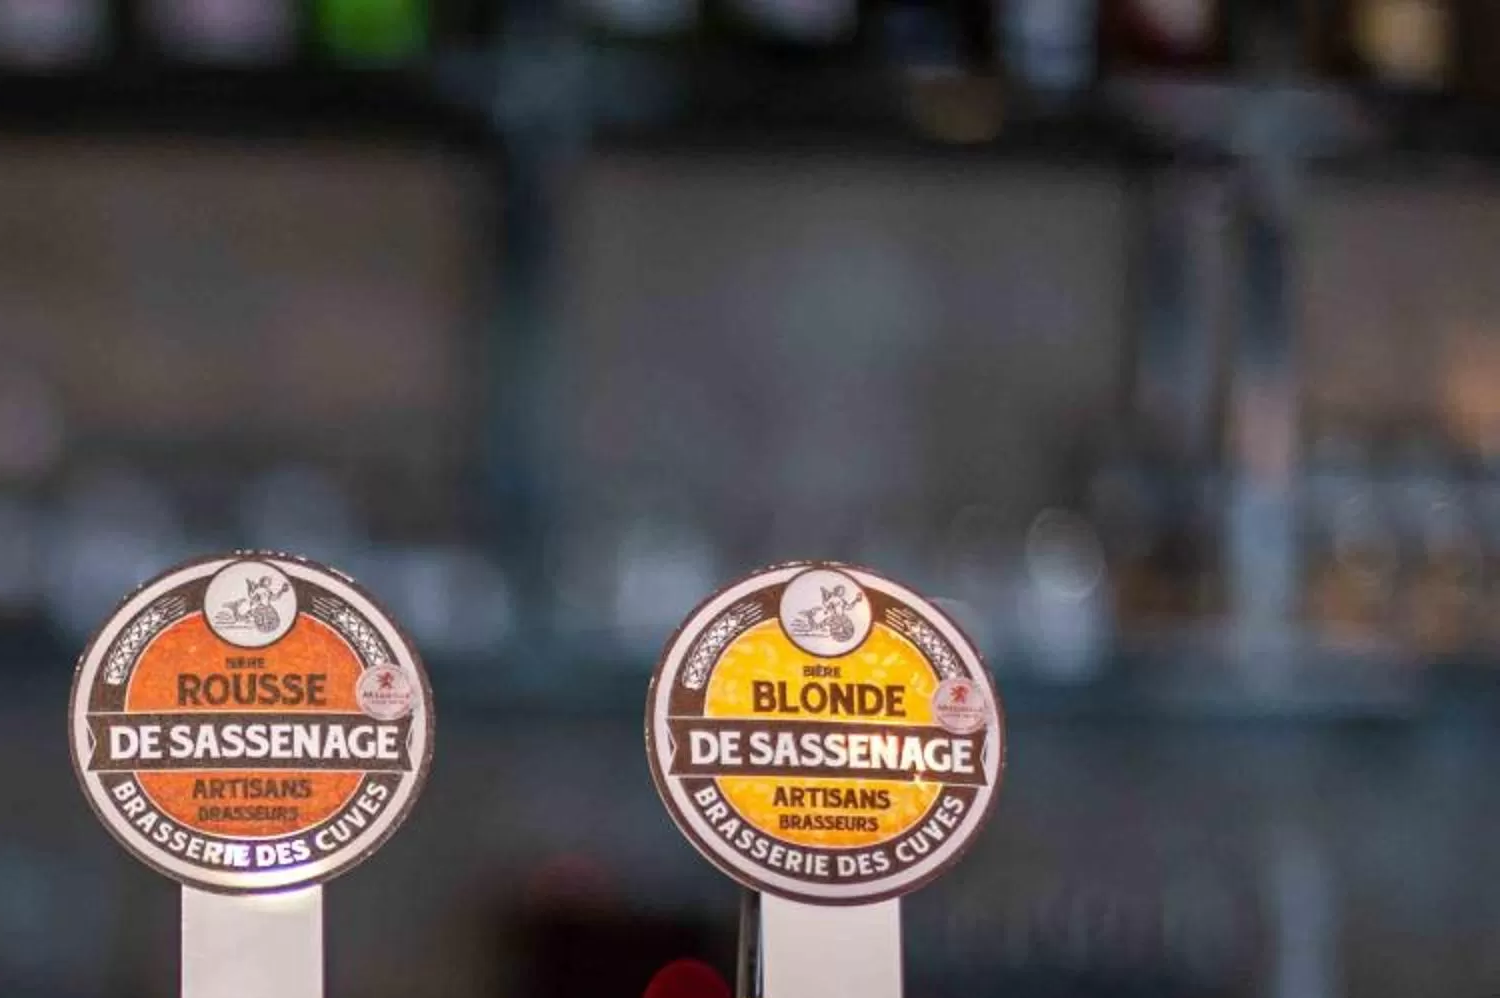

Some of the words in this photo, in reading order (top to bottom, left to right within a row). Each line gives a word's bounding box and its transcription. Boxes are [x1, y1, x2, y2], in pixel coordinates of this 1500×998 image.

[803, 664, 841, 678] BIÈRE
[177, 673, 327, 706] ROUSSE
[752, 680, 907, 717] BLONDE
[109, 724, 162, 760] DE
[169, 723, 399, 760] SASSENAGE
[689, 730, 743, 766] DE
[749, 731, 975, 774] SASSENAGE
[192, 778, 312, 799] ARTISANS
[772, 786, 891, 811] ARTISANS
[112, 780, 251, 867] BRASSERIE
[255, 838, 311, 868] DES
[315, 781, 389, 852] CUVES
[197, 805, 299, 821] BRASSEURS
[778, 813, 880, 832] BRASSEURS
[693, 786, 830, 876] BRASSERIE
[837, 850, 891, 877] DES
[895, 795, 965, 863] CUVES
